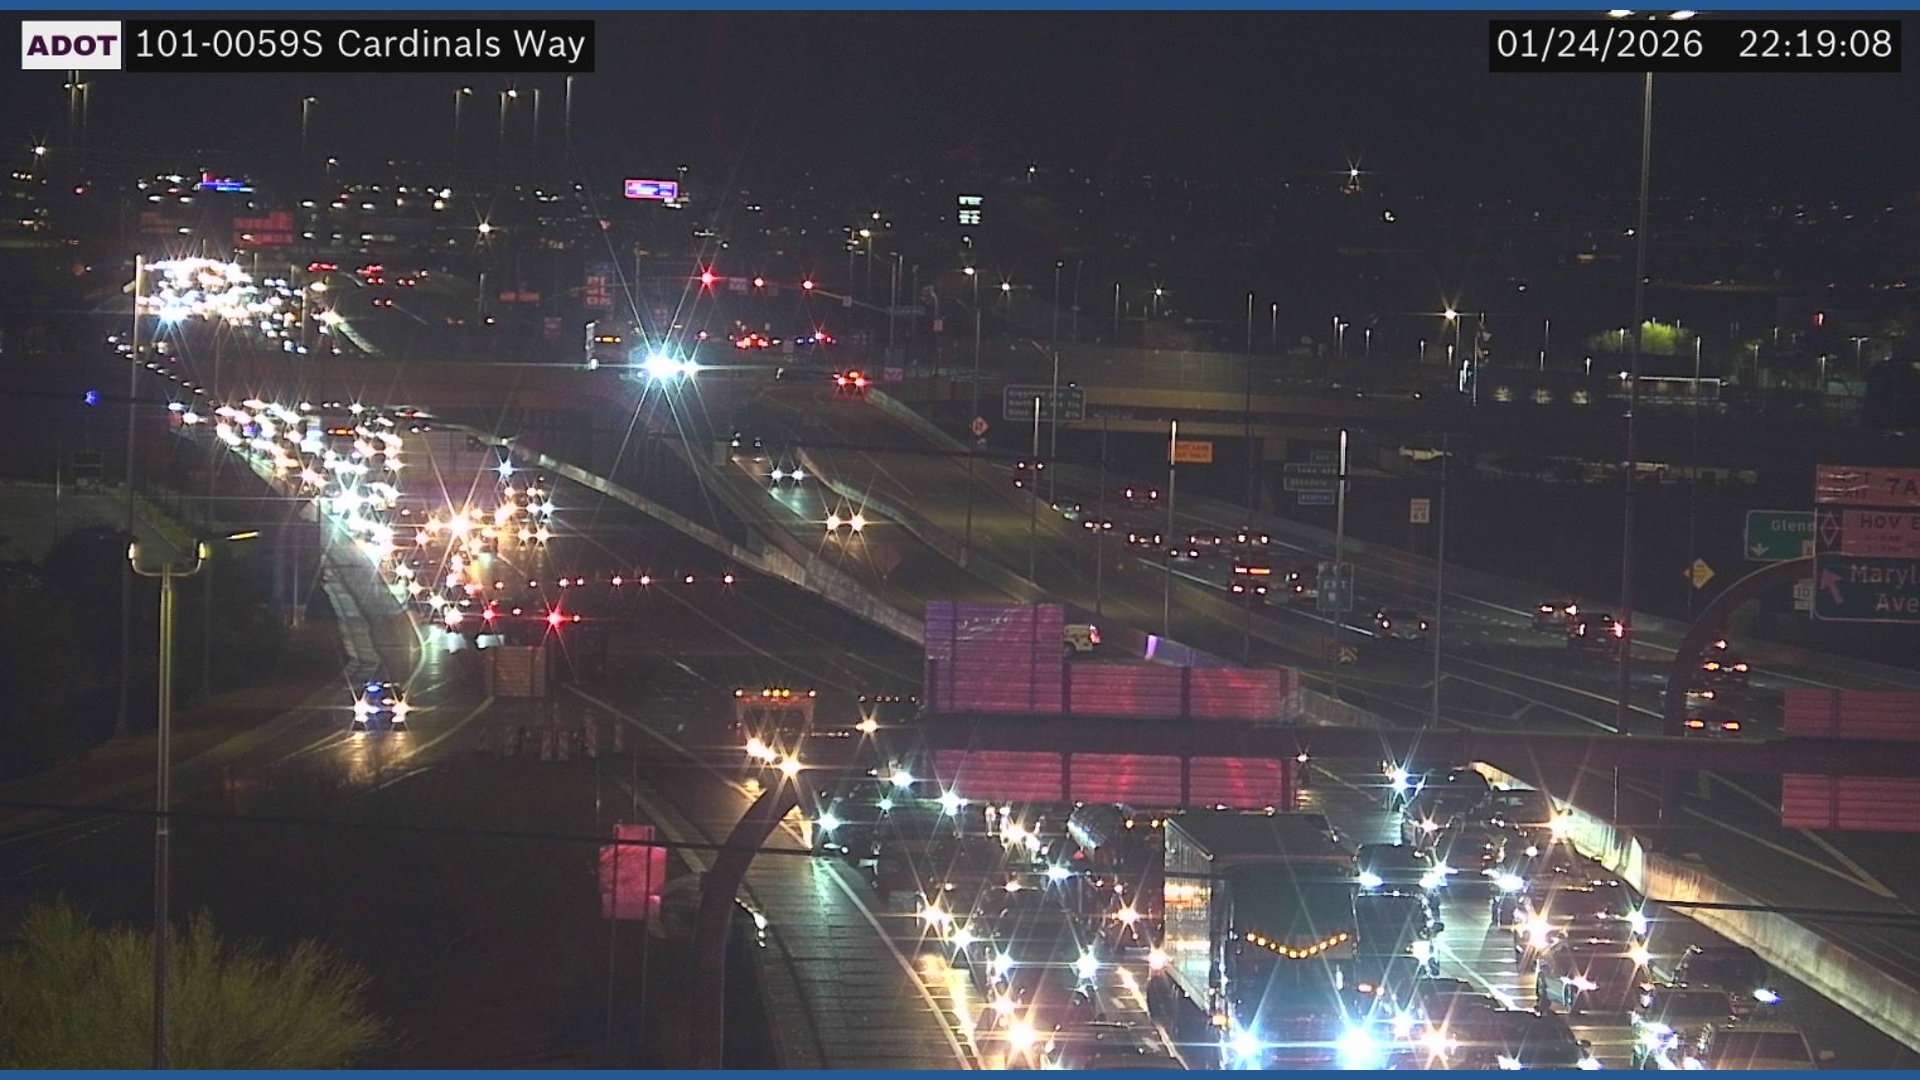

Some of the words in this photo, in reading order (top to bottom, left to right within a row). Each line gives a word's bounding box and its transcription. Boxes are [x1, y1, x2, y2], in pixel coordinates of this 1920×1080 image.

[1886, 478, 1919, 496] 7A
[1860, 514, 1900, 530] HOV
[1323, 580, 1346, 590] EXT
[1876, 593, 1920, 613] Ave
